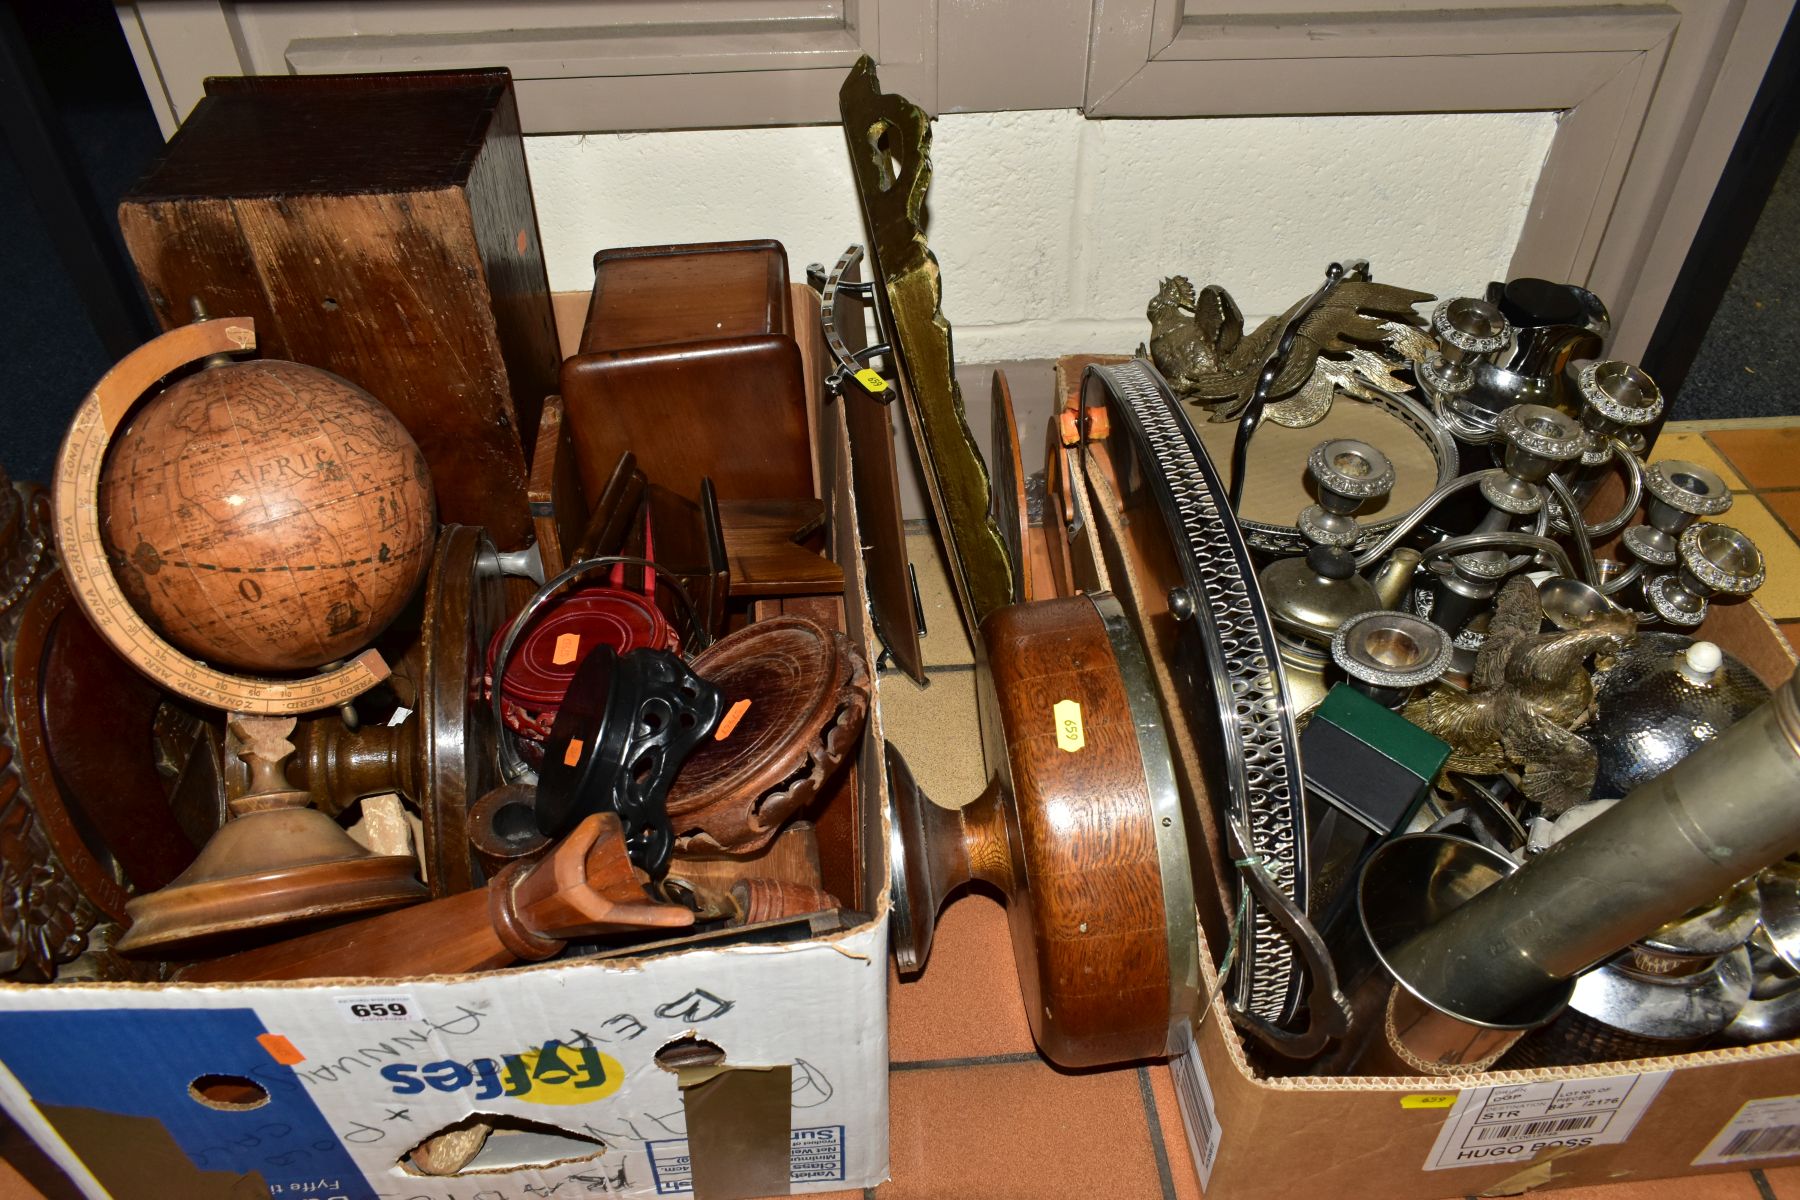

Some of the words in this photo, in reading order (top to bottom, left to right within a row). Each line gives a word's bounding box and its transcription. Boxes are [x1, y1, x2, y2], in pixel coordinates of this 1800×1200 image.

[226, 441, 360, 489] AFRICA
[1064, 719, 1079, 741] 659
[351, 1003, 408, 1018] 659
[1482, 1110, 1520, 1120] STR
[1457, 1144, 1525, 1160] HUGO
[790, 1171, 835, 1179] Variety
[290, 1178, 340, 1191] Fyffe
